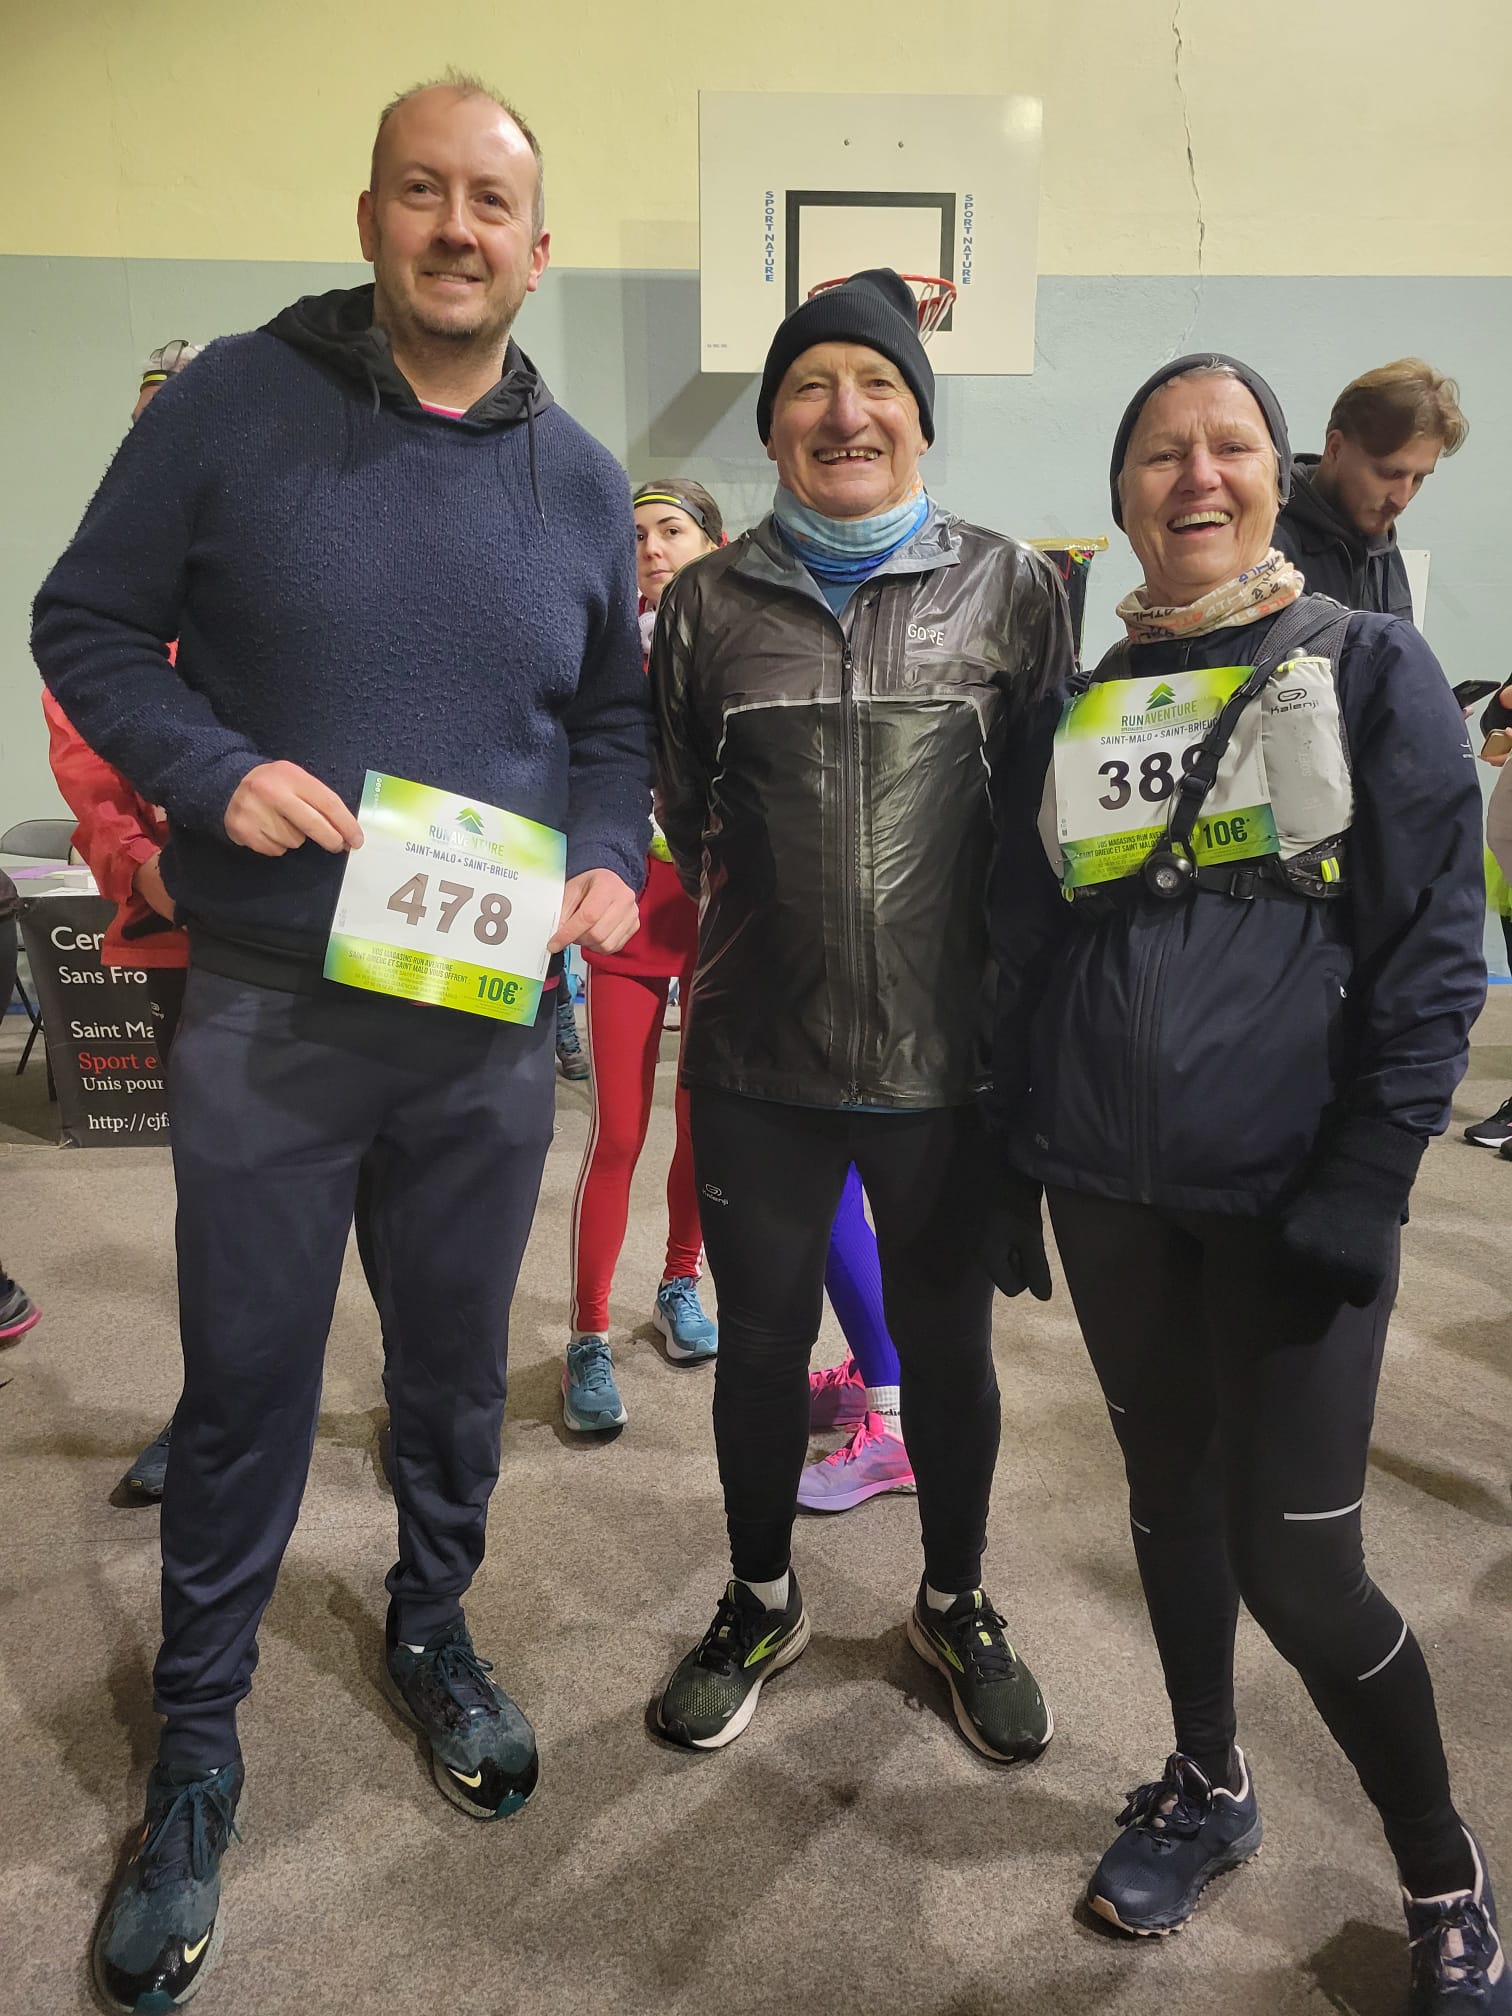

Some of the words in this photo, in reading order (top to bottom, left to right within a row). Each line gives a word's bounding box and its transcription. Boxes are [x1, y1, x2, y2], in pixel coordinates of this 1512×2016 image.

[765, 190, 775, 231] SPORT
[963, 194, 974, 234] SPORT
[765, 234, 775, 282] NATURE
[962, 237, 973, 284] NATURE
[908, 623, 945, 647] GORE
[1270, 700, 1319, 715] Kalenji
[1100, 732, 1152, 745] SAINT-MALO
[1160, 718, 1217, 739] SAINT-BRIEUC
[405, 841, 456, 864] SAINT-MALO
[463, 857, 519, 881] SAINT-BRIEUC
[387, 872, 512, 946] 478
[58, 966, 105, 984] Sans
[110, 966, 148, 985] Fro
[70, 1021, 122, 1039] Saint
[125, 1021, 154, 1039] Ma
[78, 1052, 140, 1075] Sport
[81, 1077, 122, 1091] Unis
[125, 1079, 165, 1093] pour
